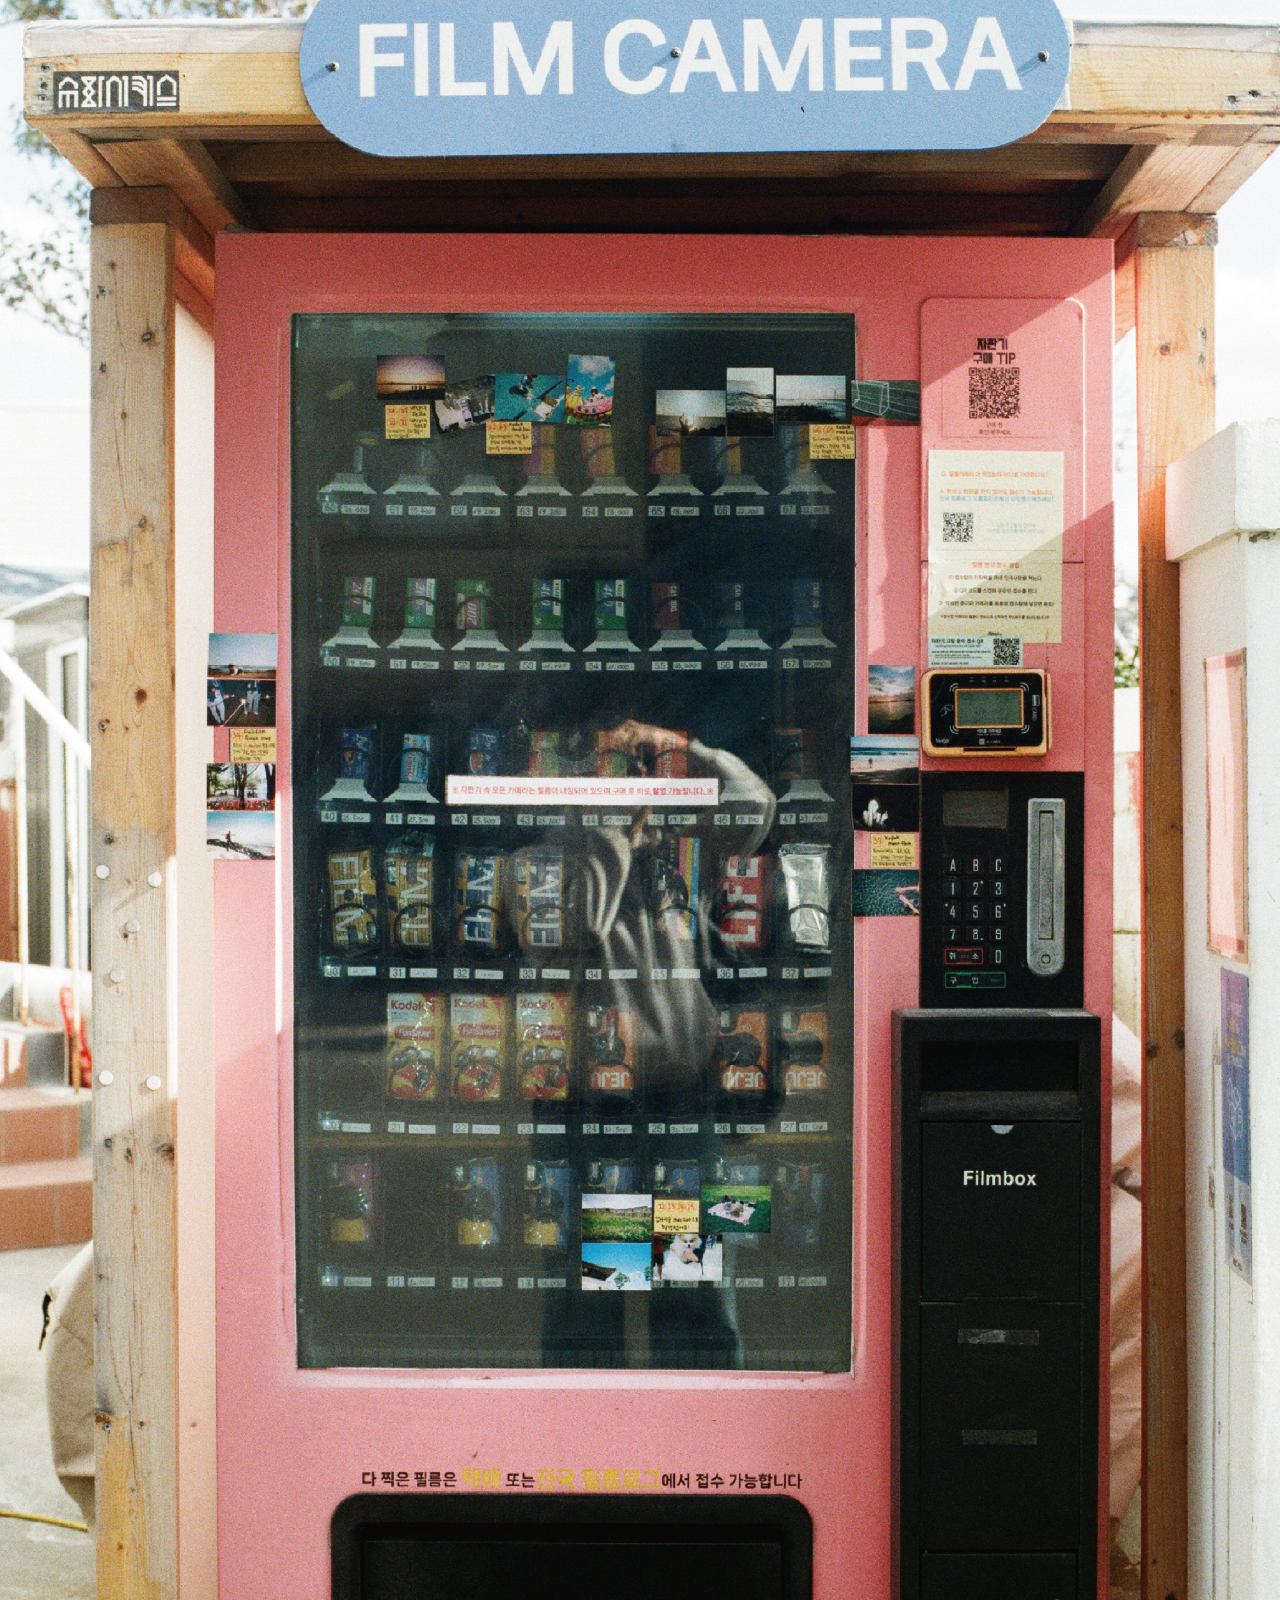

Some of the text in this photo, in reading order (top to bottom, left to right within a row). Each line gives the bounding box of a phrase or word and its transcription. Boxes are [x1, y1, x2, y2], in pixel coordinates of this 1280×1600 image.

[359, 17, 1023, 97] FILM CAMERA
[977, 337, 1008, 350] 자판기
[973, 352, 1016, 365] 구매 TIP
[468, 602, 478, 625] 200
[460, 785, 482, 794] 자판기
[492, 785, 506, 795] 모든
[508, 786, 536, 795] 카메라는
[537, 786, 558, 795] 필름이
[559, 786, 588, 795] 내장되어
[589, 786, 611, 795] 있으며
[668, 787, 706, 796] 가능합니다.
[324, 812, 335, 821] 40
[390, 814, 400, 823] 41
[454, 815, 466, 824] 42
[521, 815, 531, 824] 43
[585, 816, 596, 824] 44
[783, 814, 794, 823] 47
[949, 859, 1002, 872] A B C
[972, 882, 979, 895] 2
[995, 882, 1002, 895] 3
[330, 856, 364, 941] FILM
[721, 856, 759, 944] LIFE
[400, 866, 430, 946] FILM
[529, 865, 560, 947] FILM
[949, 905, 1002, 918] 4 5 6
[949, 928, 1002, 940] 7 8 9
[949, 952, 956, 960] 취
[995, 949, 1002, 964] 0
[392, 968, 402, 978] 31
[456, 969, 468, 978] 32
[522, 969, 534, 979] 33
[588, 970, 599, 979] 34
[720, 969, 731, 978] 36
[785, 969, 796, 978] 37
[950, 976, 979, 985] 구 입
[390, 999, 424, 1010] Kodak
[454, 998, 488, 1009] Kodak
[520, 998, 554, 1010] Kodak
[590, 1072, 630, 1088] JEJU
[722, 1072, 763, 1088] JEJU
[785, 1072, 826, 1088] JEJU
[455, 1124, 467, 1133] 22
[586, 1124, 597, 1134] 24
[651, 1124, 663, 1133] 25
[717, 1124, 728, 1132] 26
[783, 1122, 794, 1131] 27
[963, 1170, 1037, 1186] Filmbox
[390, 1277, 400, 1286] 11
[362, 1471, 376, 1487] 다
[381, 1471, 410, 1487] 찍은
[414, 1471, 457, 1487] 필름은
[462, 1467, 501, 1489] 택배
[506, 1473, 535, 1488] 또는
[536, 1468, 575, 1490] 전국
[696, 1473, 725, 1489] 접수
[729, 1472, 803, 1489] 가능합니다
